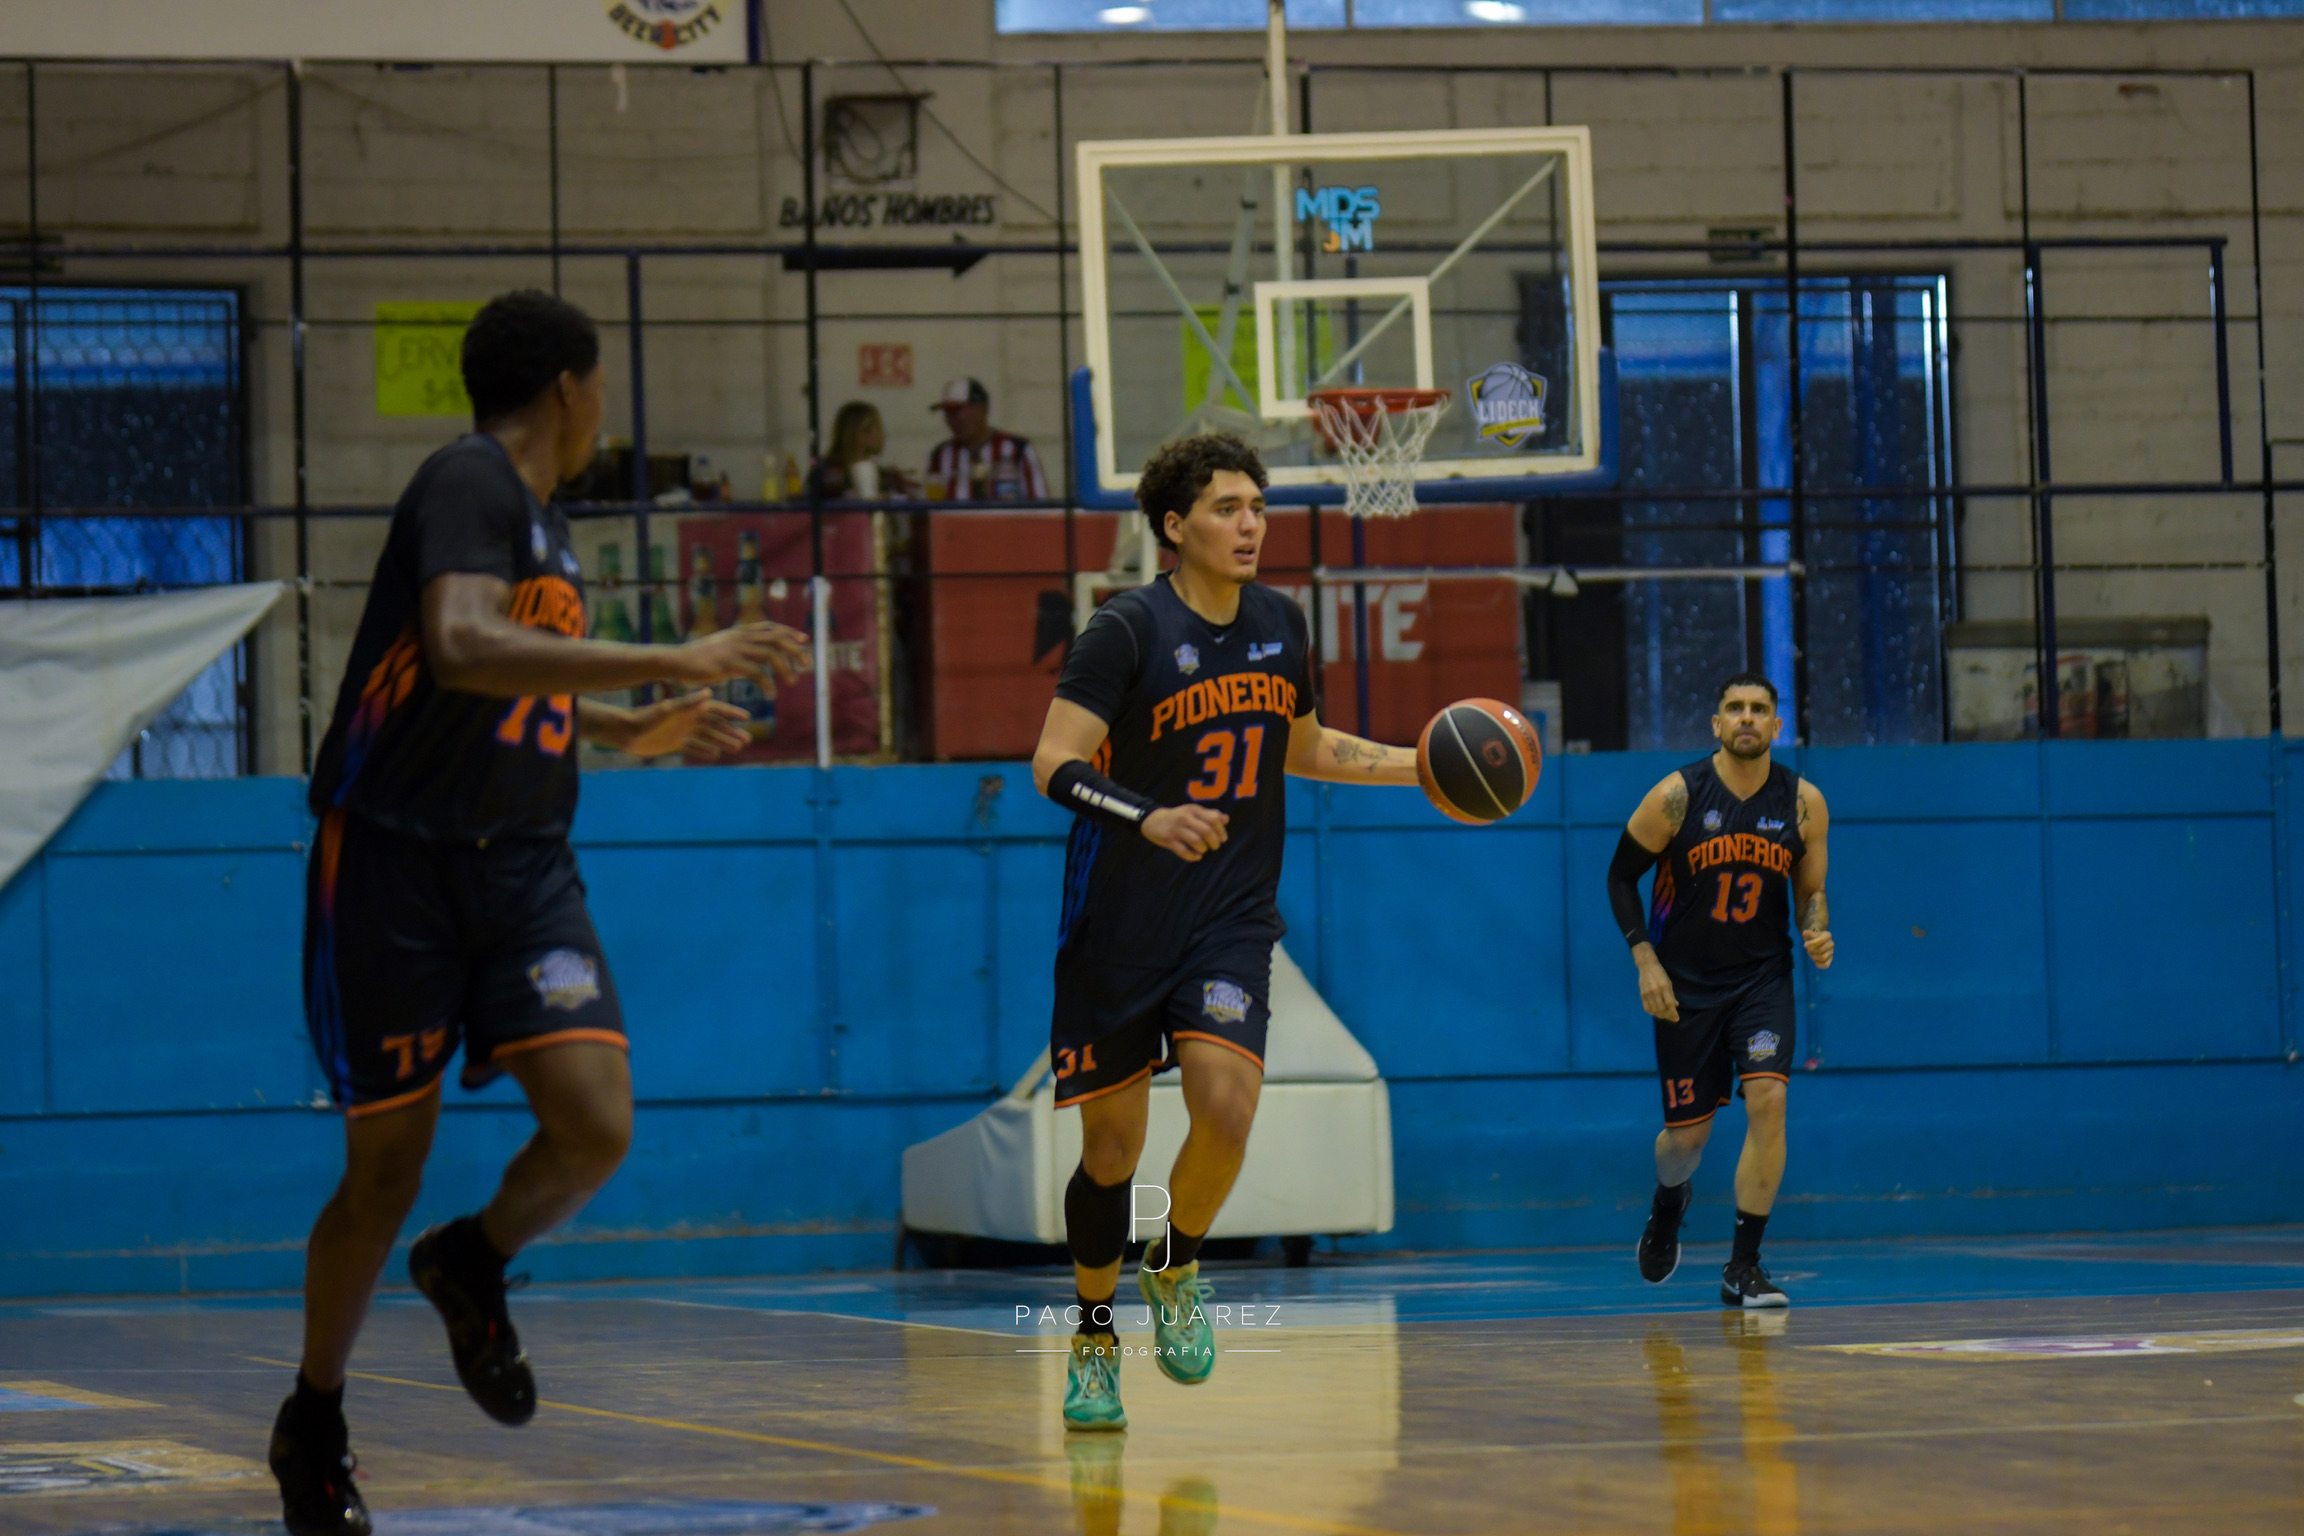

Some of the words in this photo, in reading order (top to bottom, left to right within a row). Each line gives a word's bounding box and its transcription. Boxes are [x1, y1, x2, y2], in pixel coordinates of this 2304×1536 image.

[881, 194, 995, 226] HOMBRES
[1296, 187, 1380, 221] MDS
[1151, 672, 1297, 742] PIONEROS
[1187, 725, 1265, 801] 31
[1687, 832, 1793, 879] PIONEROS
[1711, 872, 1763, 923] 13
[1666, 1077, 1695, 1109] 13
